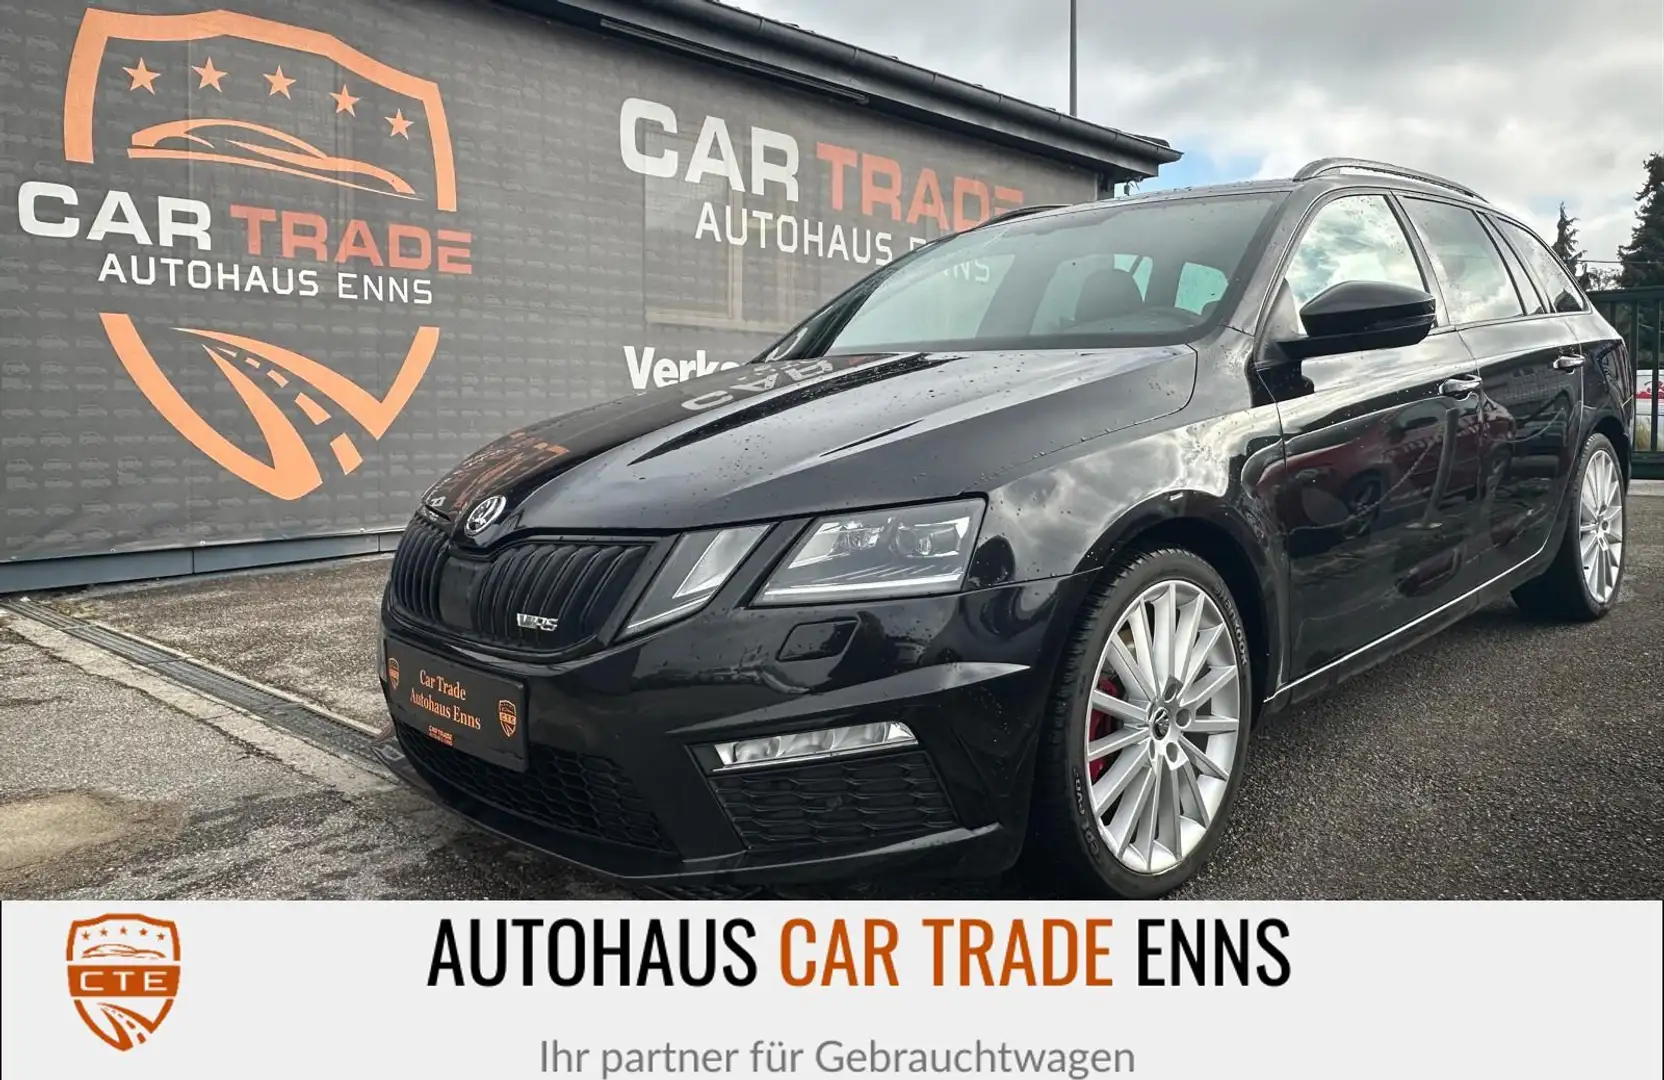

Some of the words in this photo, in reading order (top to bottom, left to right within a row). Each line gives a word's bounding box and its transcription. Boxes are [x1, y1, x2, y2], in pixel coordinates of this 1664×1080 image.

[620, 97, 799, 203] CAR
[18, 181, 212, 250] CAR
[230, 204, 472, 274] TRADE
[695, 203, 893, 267] AUTOHAUS
[98, 253, 319, 297] AUTOHAUS
[338, 273, 433, 305] ENNS
[409, 687, 451, 719] Autohaus
[453, 704, 481, 730] Enns
[419, 669, 436, 689] Car
[437, 675, 467, 701] Trade
